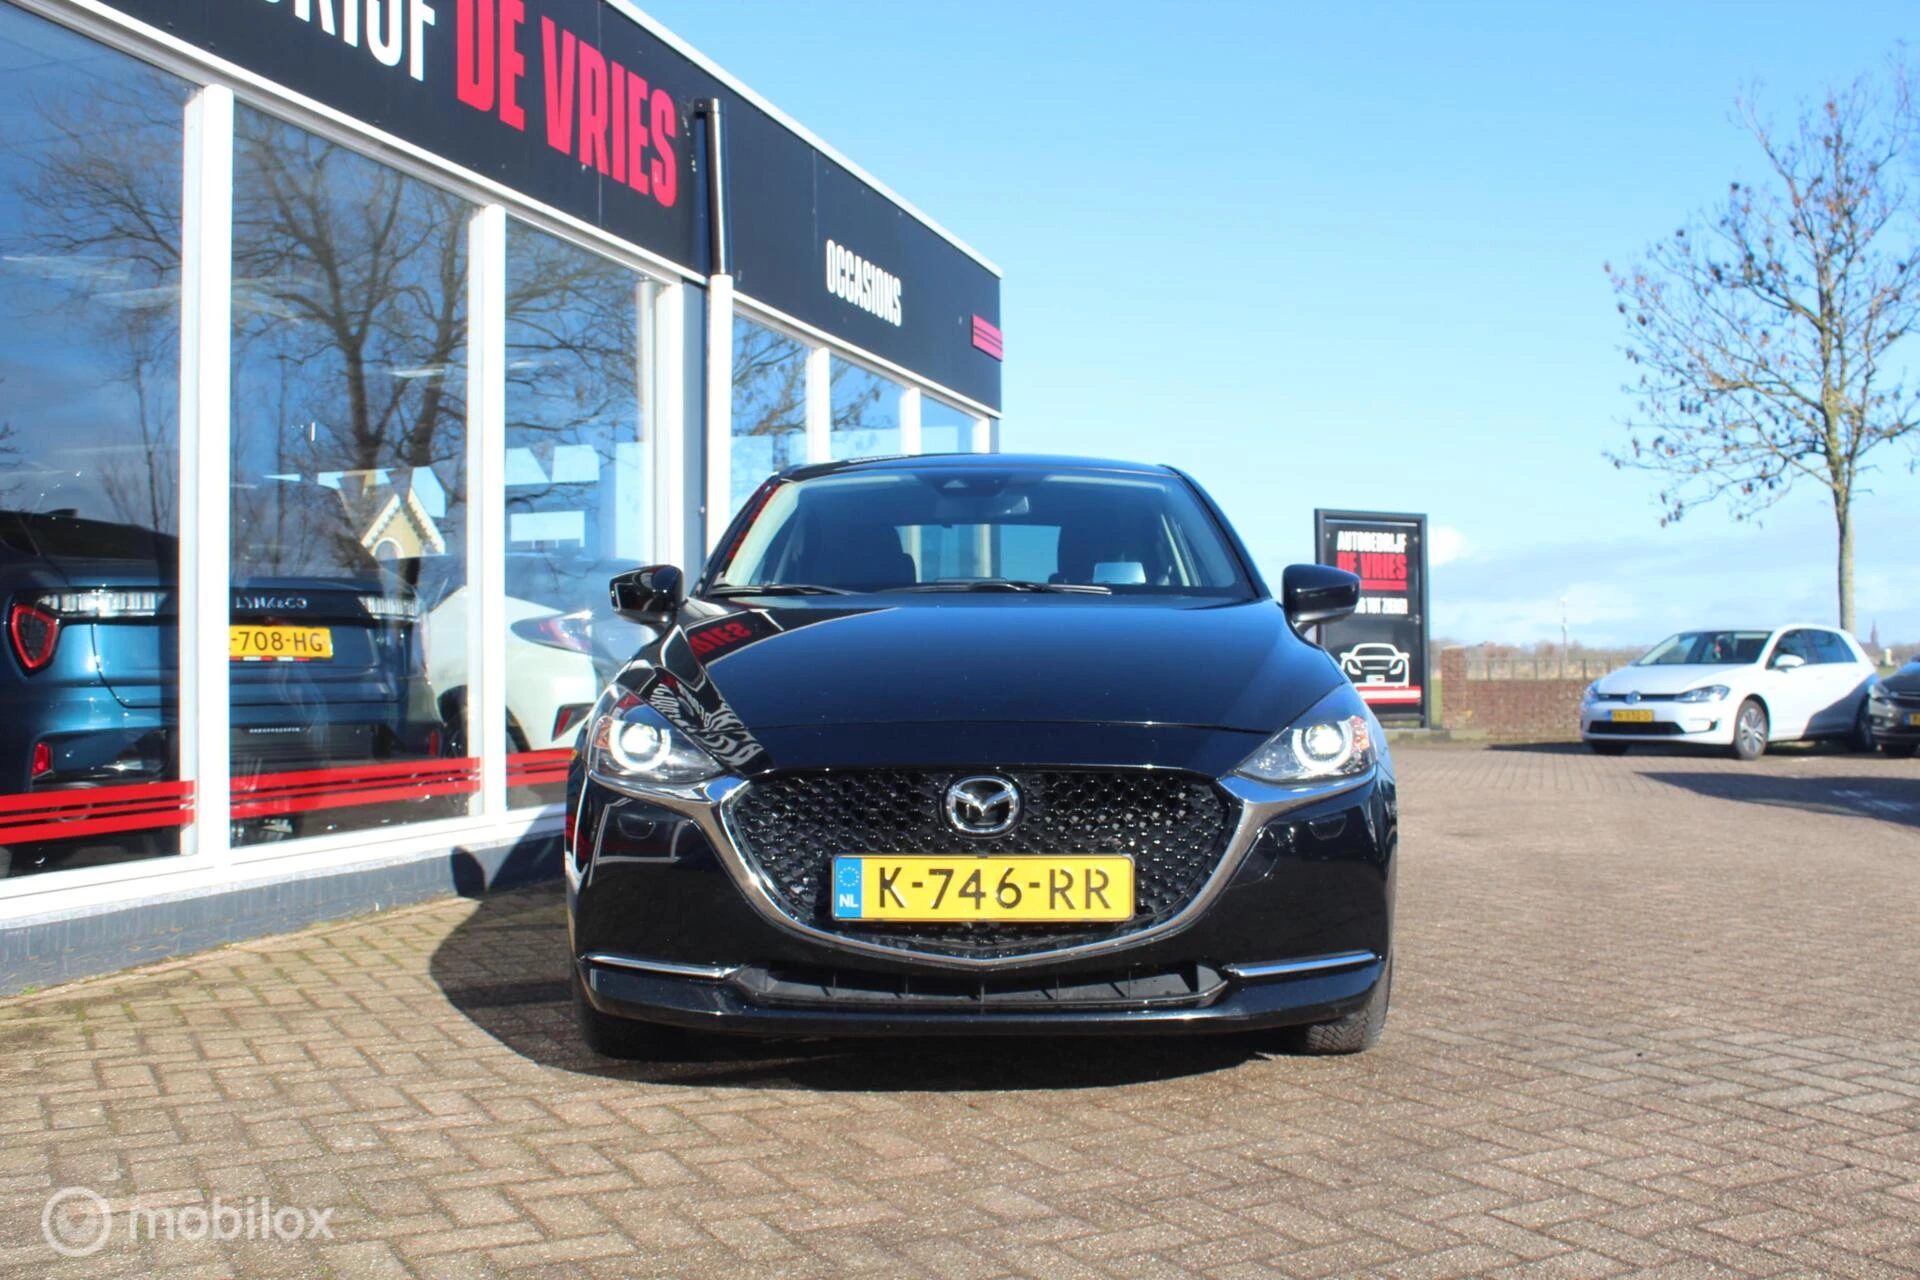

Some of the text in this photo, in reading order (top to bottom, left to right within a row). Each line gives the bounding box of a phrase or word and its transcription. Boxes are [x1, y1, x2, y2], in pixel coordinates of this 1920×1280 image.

[540, 14, 678, 208] VRIES
[826, 238, 902, 328] OCCASIONS
[1360, 552, 1409, 580] VRIES
[230, 631, 323, 652] -708-HG
[838, 866, 1112, 910] NL K-746-RR
